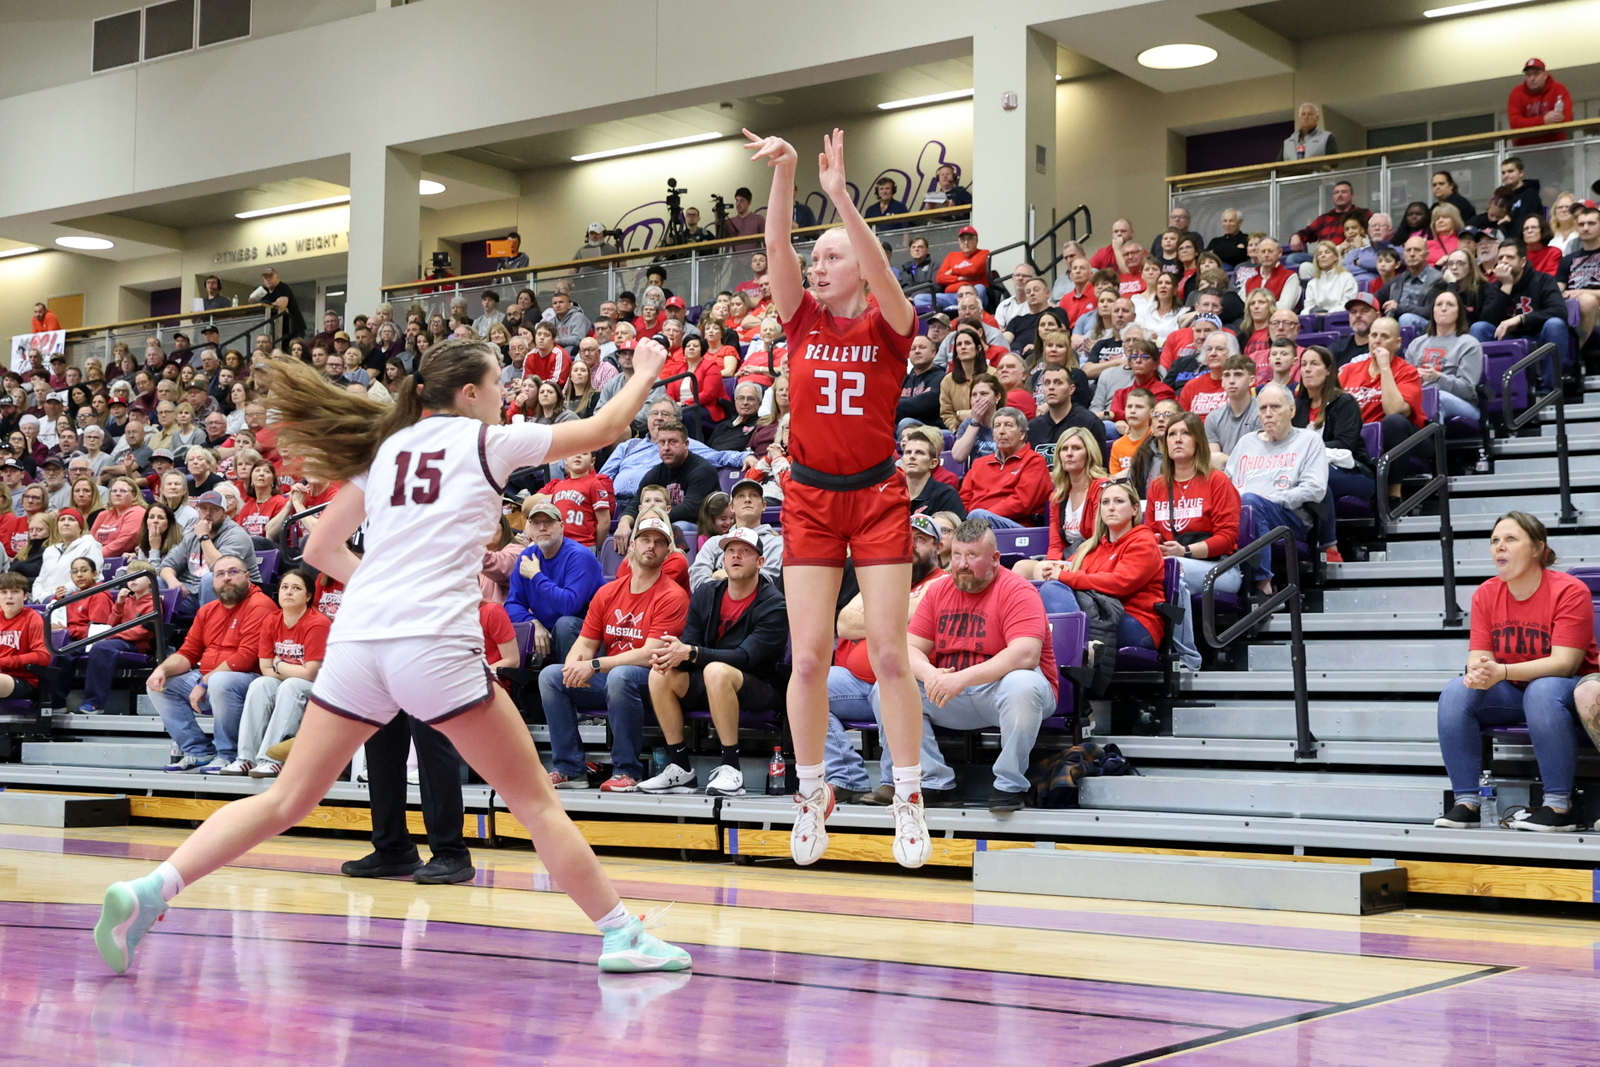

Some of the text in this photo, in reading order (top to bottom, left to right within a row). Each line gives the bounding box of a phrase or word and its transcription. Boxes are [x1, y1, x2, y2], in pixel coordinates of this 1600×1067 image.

[265, 242, 288, 257] AND
[295, 234, 339, 252] WEIGHT
[804, 343, 879, 363] BELLEVUE
[813, 369, 866, 416] 32
[390, 448, 446, 507] 15
[1237, 454, 1266, 489] OHIO
[1265, 452, 1298, 469] STATE
[565, 509, 585, 526] 30
[605, 624, 644, 640] BASEBALL
[937, 612, 987, 638] STATE
[1491, 626, 1552, 655] STATE
[1083, 727, 1090, 737] A
